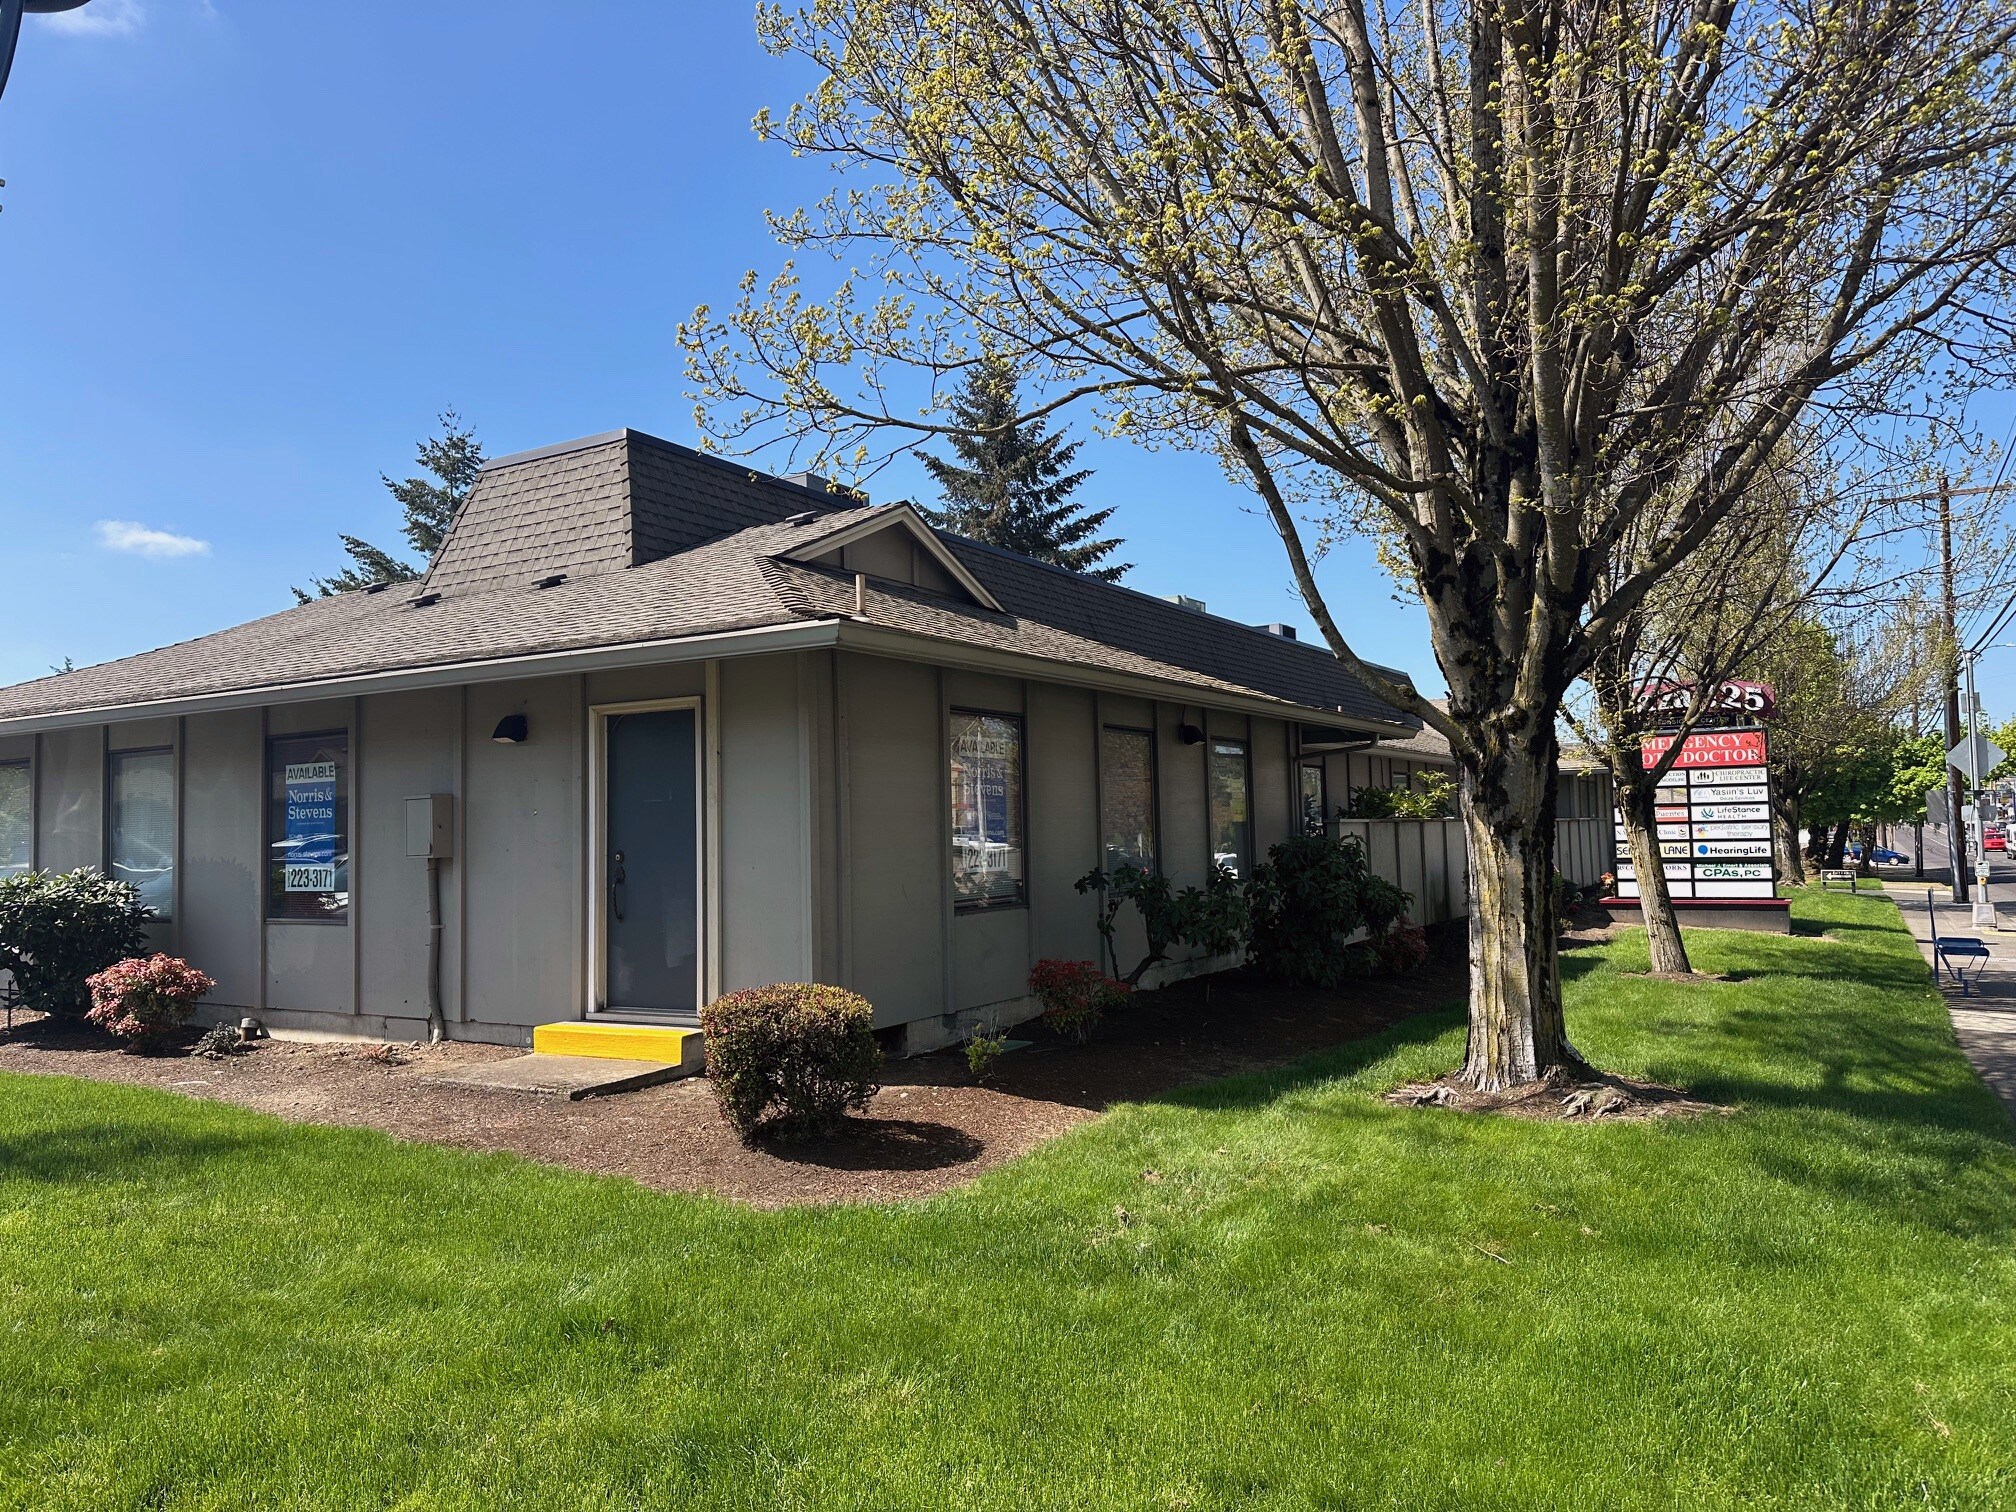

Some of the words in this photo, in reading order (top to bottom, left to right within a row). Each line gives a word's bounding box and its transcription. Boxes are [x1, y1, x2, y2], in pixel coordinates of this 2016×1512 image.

[1683, 748, 1758, 763] DOCTOR
[287, 765, 335, 780] AVAILABLE
[288, 788, 324, 804] Norris
[324, 787, 333, 801] &
[1711, 788, 1744, 796] Yasiin's
[288, 805, 333, 820] Stevens
[1717, 806, 1761, 814] LifeStance
[1710, 823, 1740, 831] pediatric
[1741, 823, 1769, 831] sensory
[1663, 845, 1688, 855] LANE
[1709, 846, 1768, 856] HearingLife
[1744, 869, 1762, 877] PC
